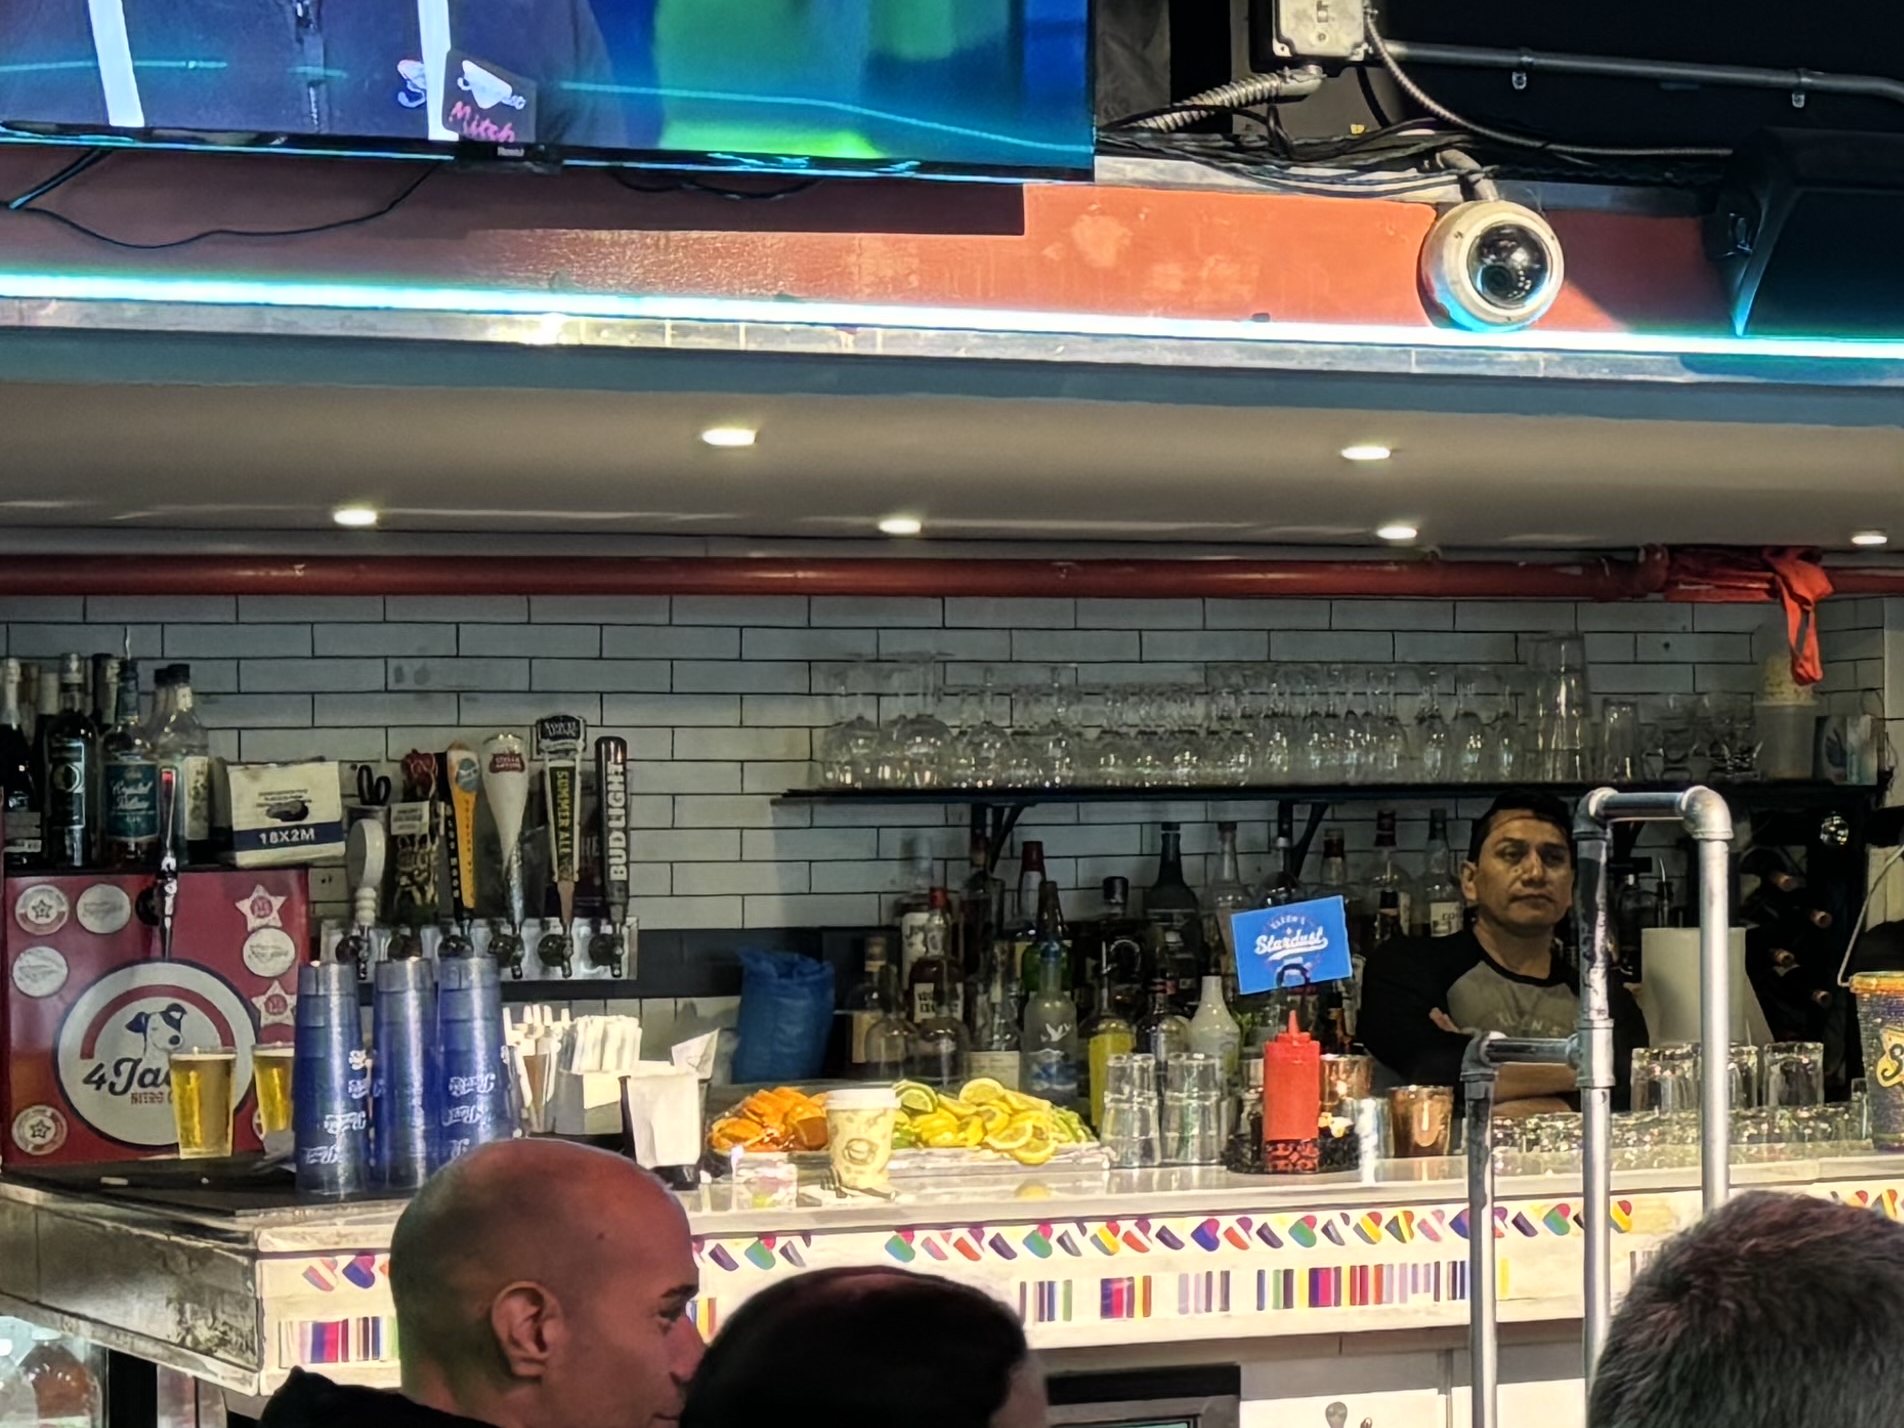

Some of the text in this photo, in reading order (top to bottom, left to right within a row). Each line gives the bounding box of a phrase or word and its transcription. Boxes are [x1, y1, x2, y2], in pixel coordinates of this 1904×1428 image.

[556, 770, 572, 827] SUMMER
[258, 827, 316, 846] 18X2M
[607, 761, 628, 881] BUD LIGHT
[1254, 925, 1329, 955] Stardust
